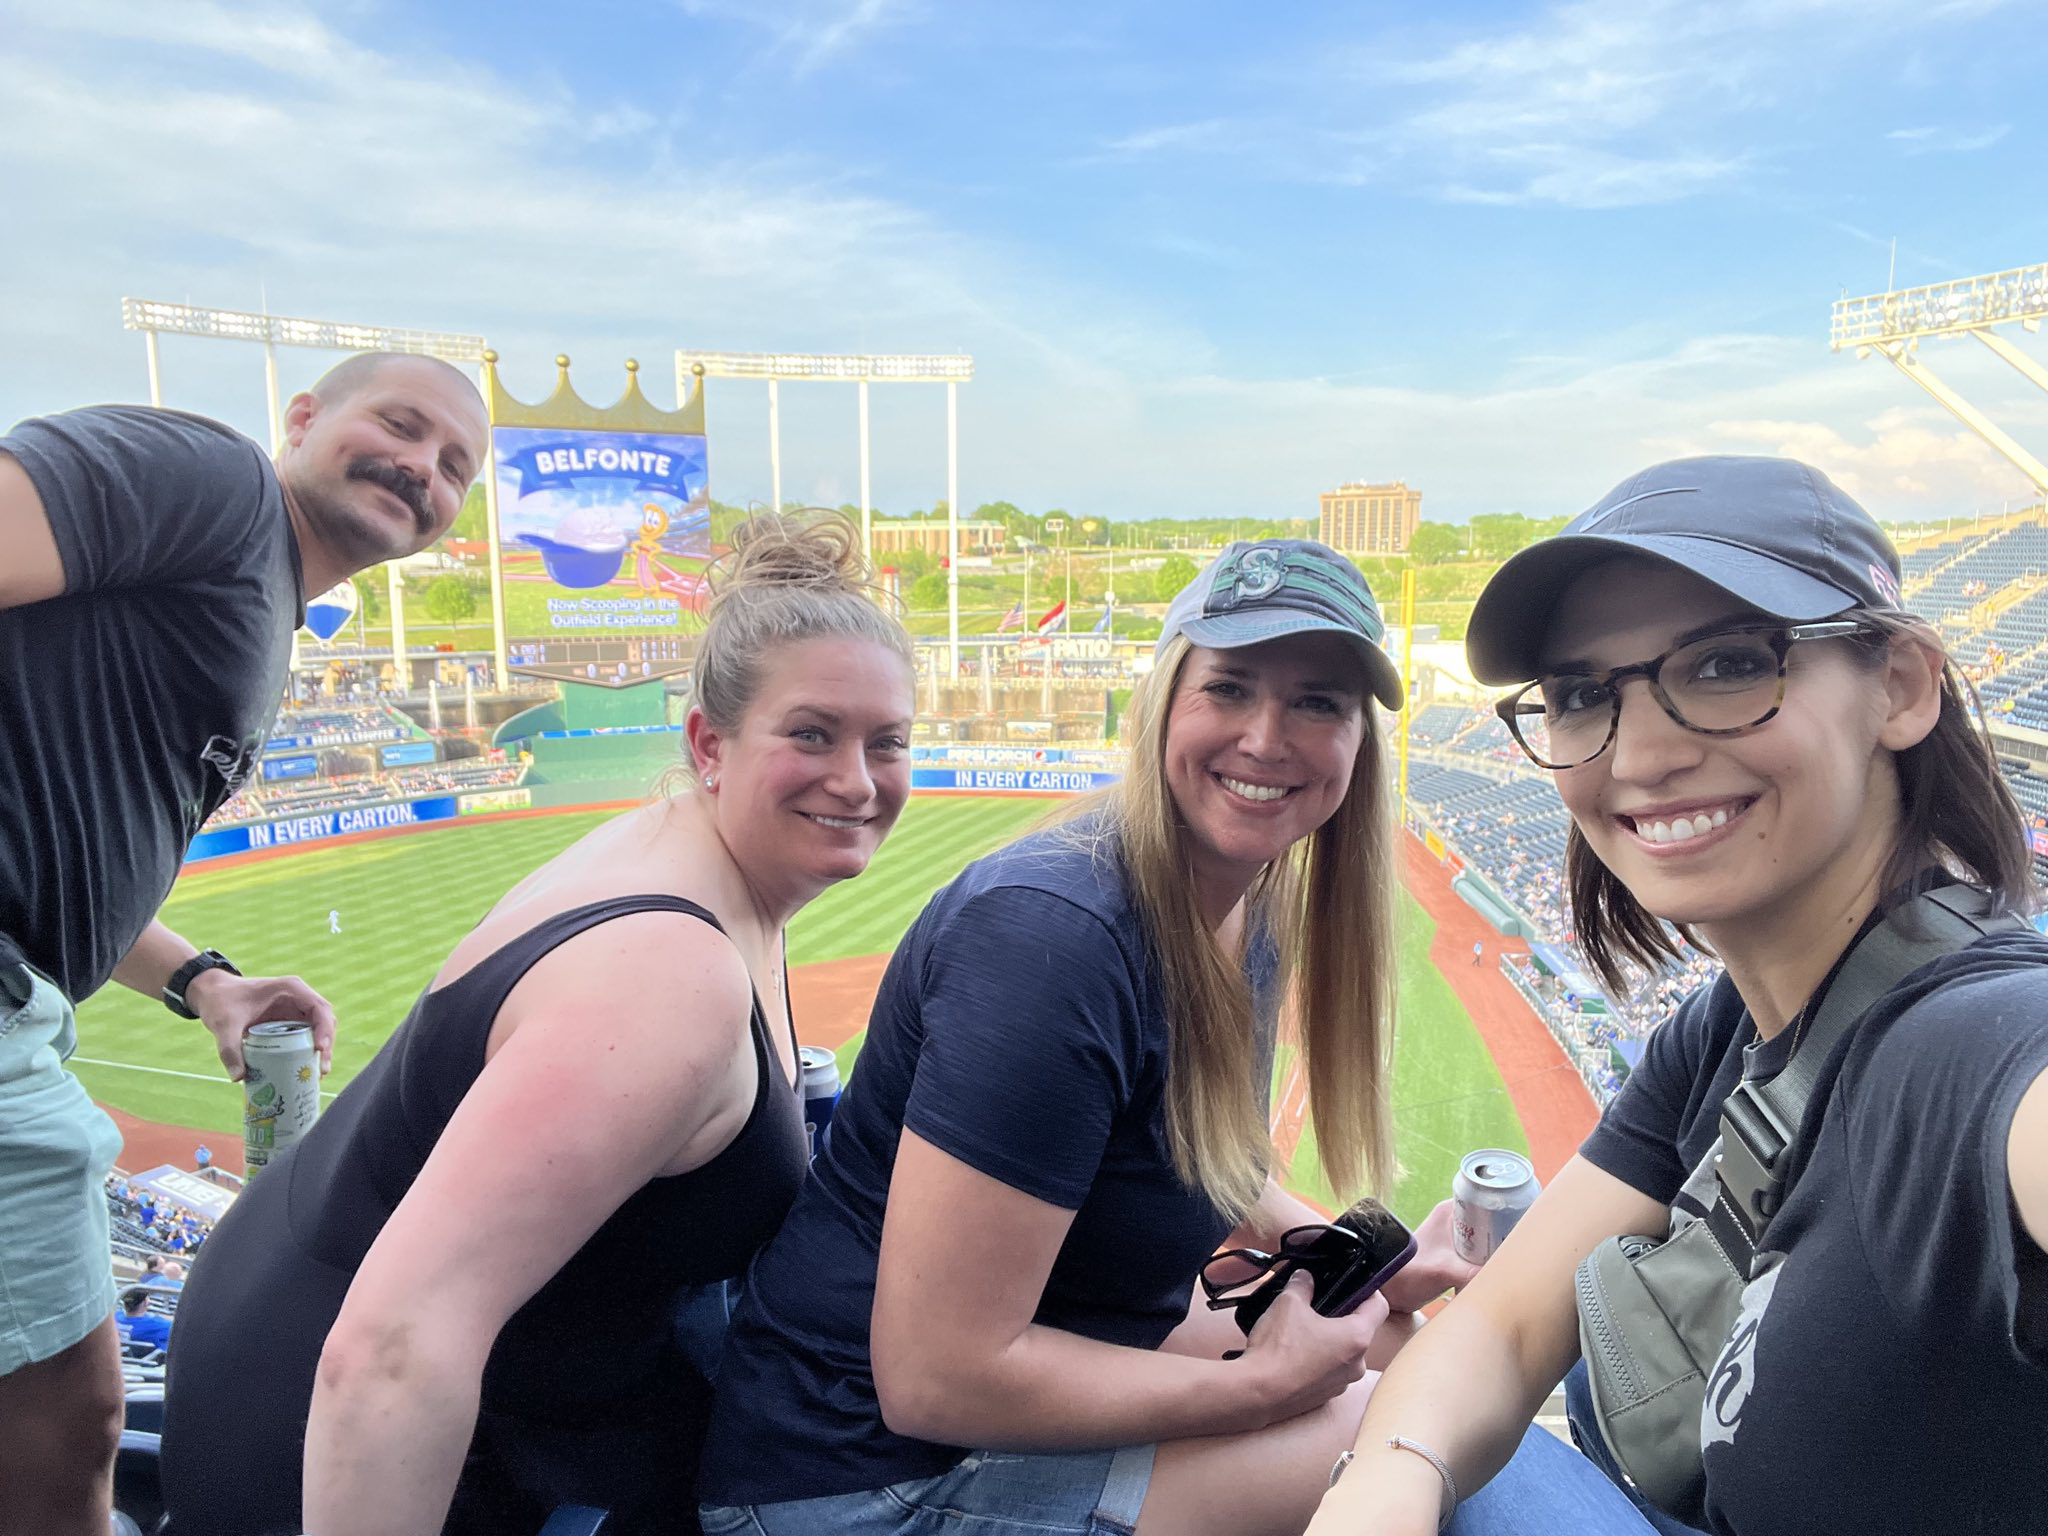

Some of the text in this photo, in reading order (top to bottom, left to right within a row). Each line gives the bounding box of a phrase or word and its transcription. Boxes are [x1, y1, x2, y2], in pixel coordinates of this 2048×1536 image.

[534, 448, 672, 477] BELFONTE
[548, 598, 679, 612] Now Scooping in the
[551, 613, 678, 627] Outfield Experience!
[1053, 638, 1109, 658] PATIO
[956, 771, 972, 787] IN
[976, 771, 1025, 788] EVERY
[248, 802, 417, 848] IN EVERY CARTON.
